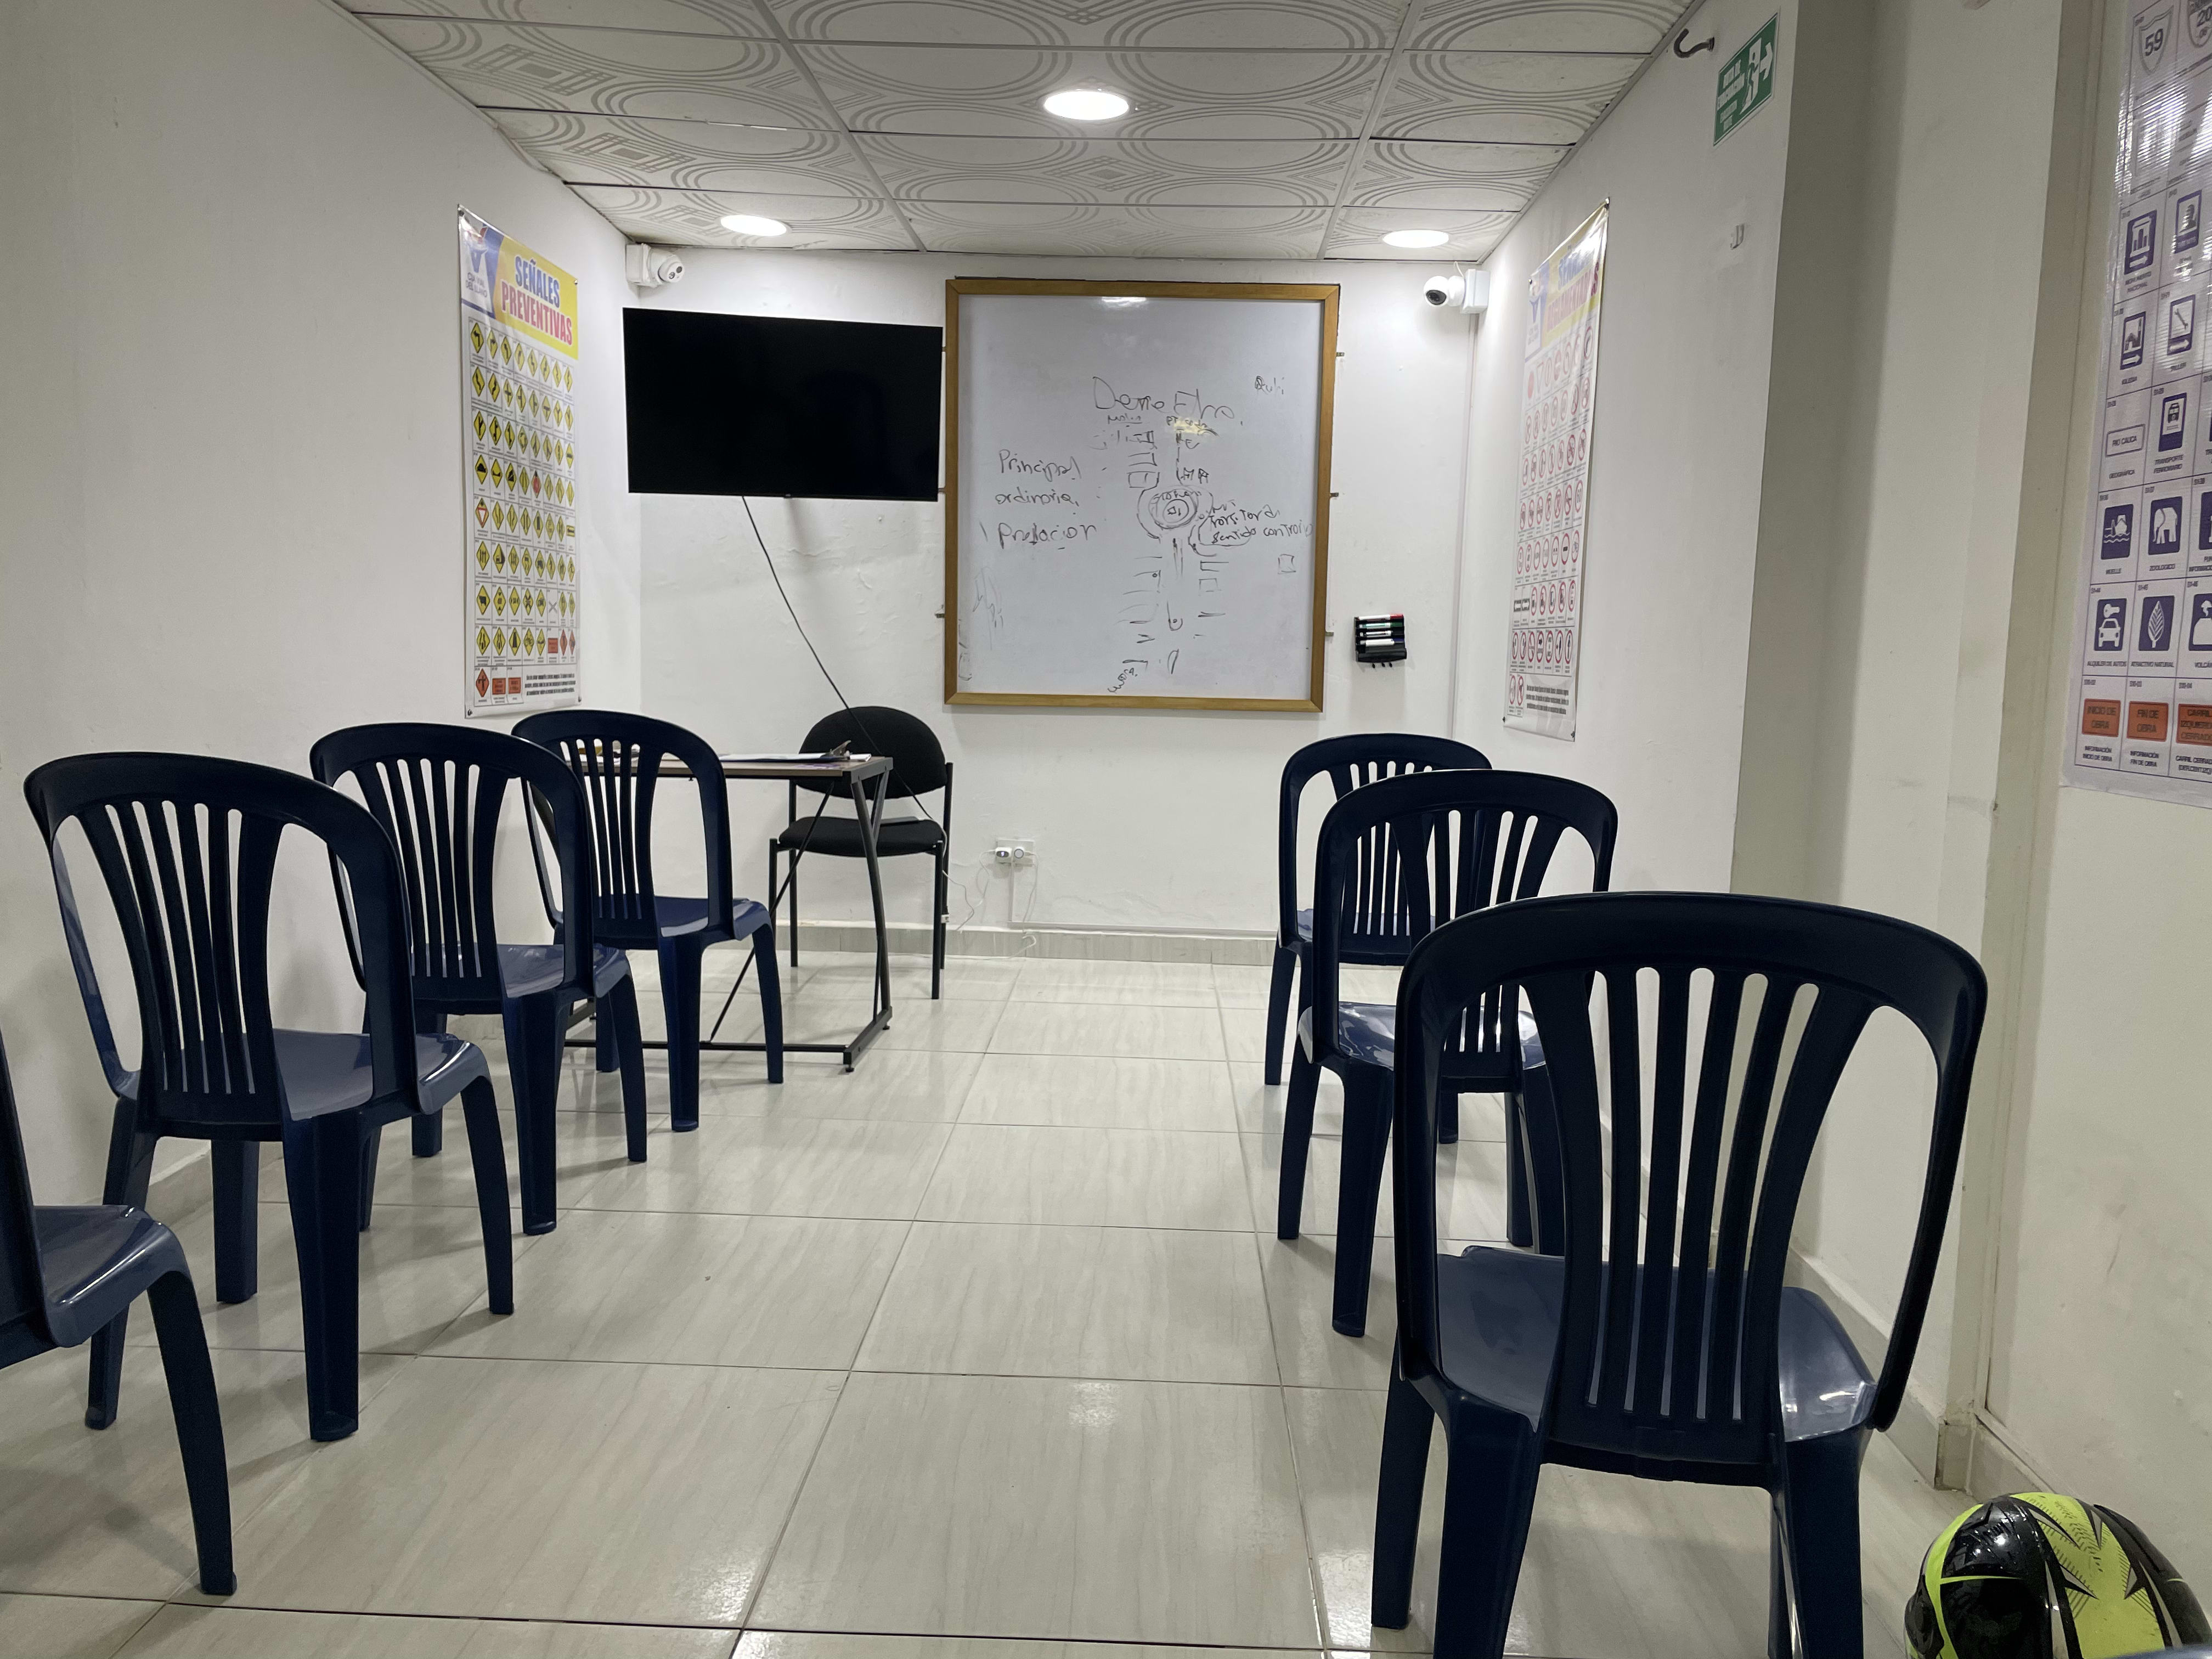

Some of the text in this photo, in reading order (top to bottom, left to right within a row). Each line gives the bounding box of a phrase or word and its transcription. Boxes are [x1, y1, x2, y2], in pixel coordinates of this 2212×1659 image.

[2145, 29, 2164, 57] 59
[515, 256, 560, 308] SEÑALES
[501, 281, 572, 345] PREVENTIVAS
